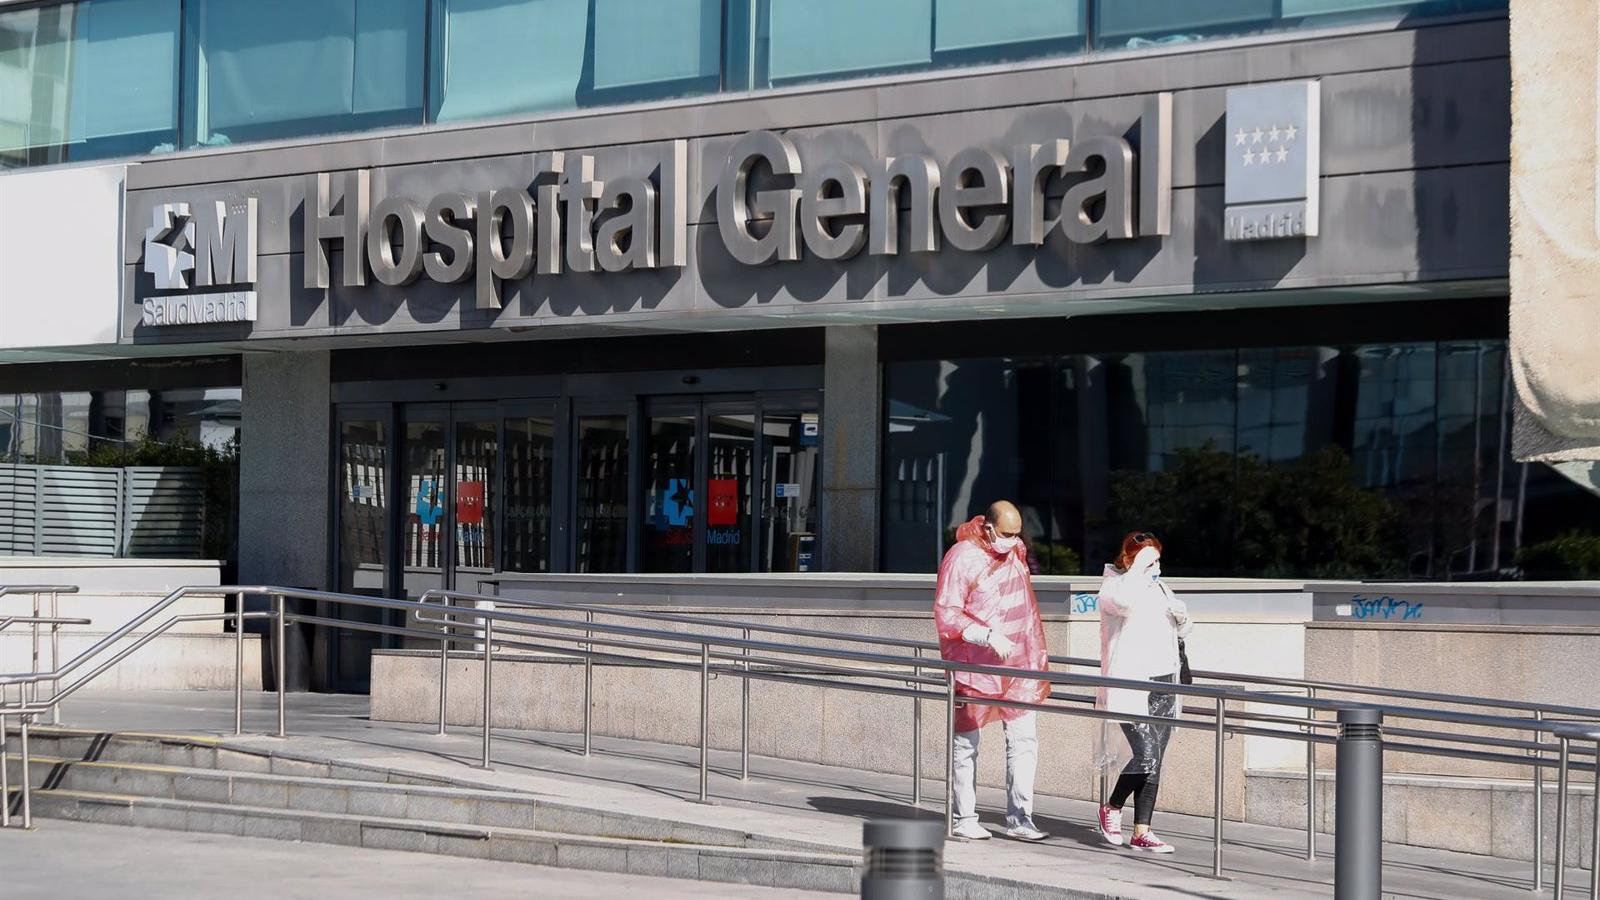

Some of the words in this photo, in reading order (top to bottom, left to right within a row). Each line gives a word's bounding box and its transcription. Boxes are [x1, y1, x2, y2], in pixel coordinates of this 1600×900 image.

[303, 139, 688, 309] Hospital
[716, 92, 1173, 266] General
[1225, 211, 1305, 239] Madrid
[142, 292, 254, 327] SaludMadrid
[706, 528, 740, 545] Madrid
